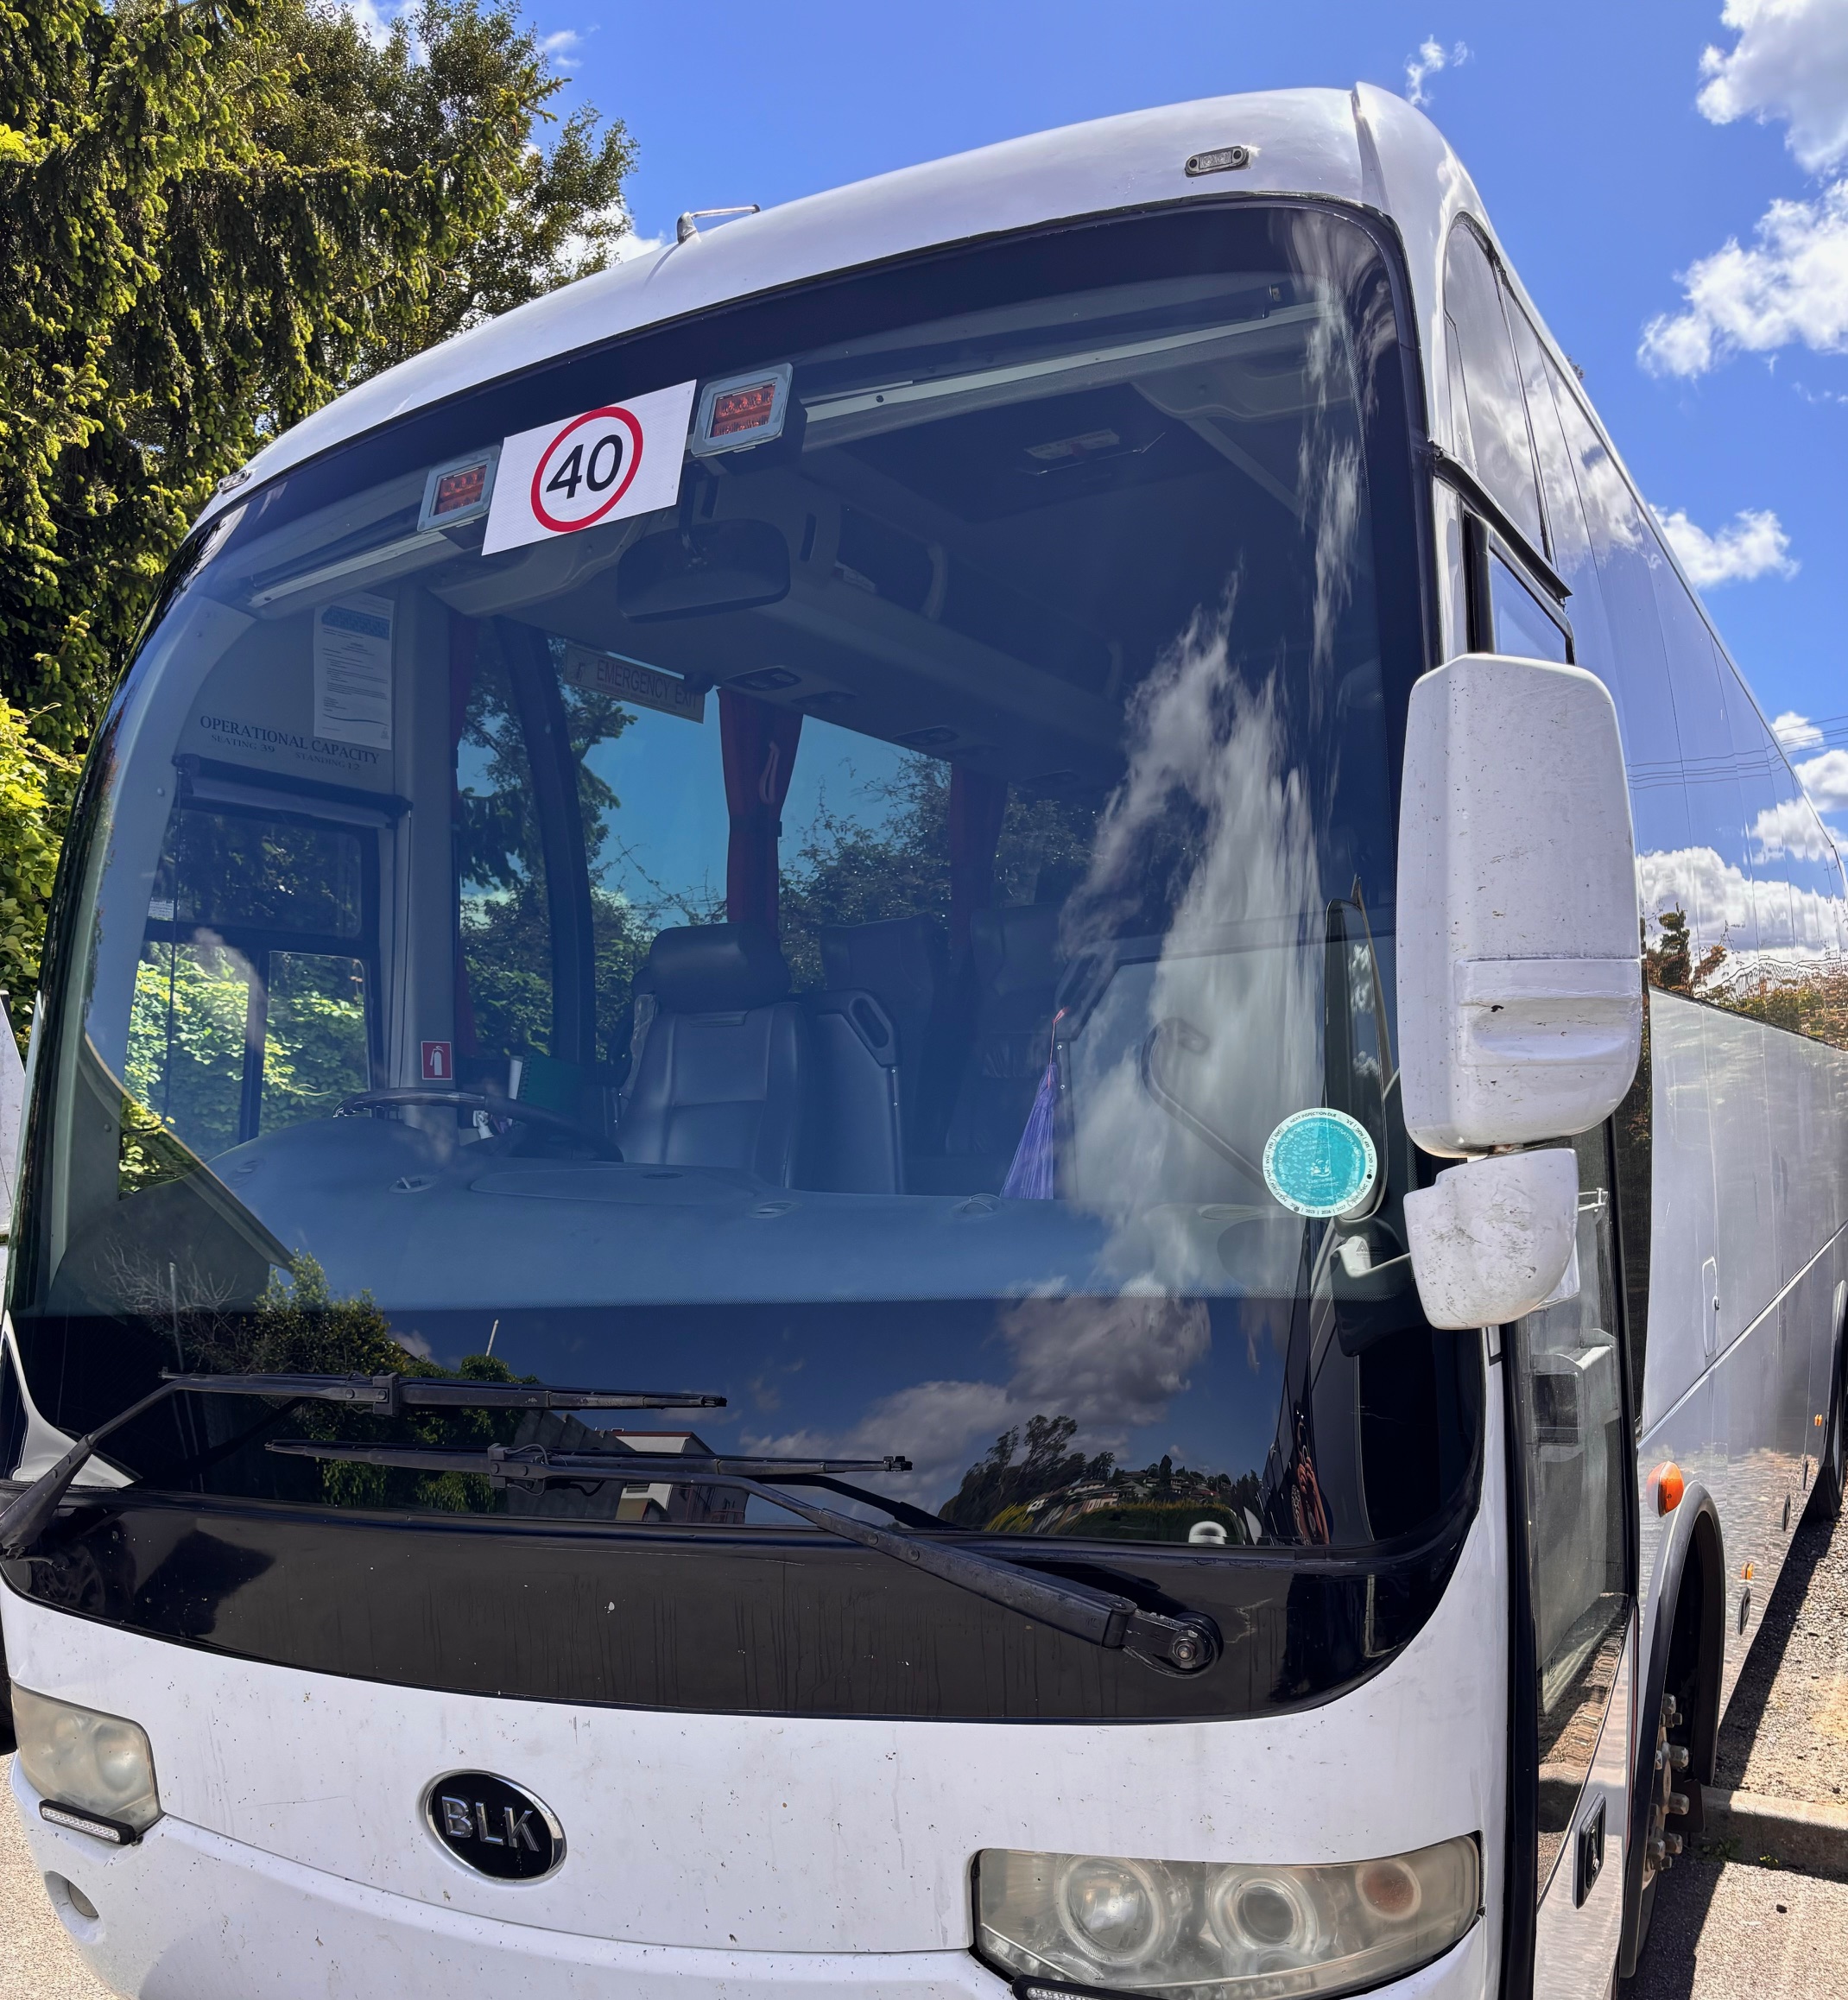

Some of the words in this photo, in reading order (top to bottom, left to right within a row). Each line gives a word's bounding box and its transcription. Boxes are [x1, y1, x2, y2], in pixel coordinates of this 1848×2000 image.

[546, 434, 623, 499] 40
[596, 659, 670, 699] EMERGENCY
[199, 715, 307, 750] OPERATIONAL
[311, 739, 380, 764] CAPACITY
[211, 734, 257, 750] SEATING
[260, 744, 275, 754] 39
[294, 751, 346, 769] STANDING
[441, 1795, 540, 1852] BLK
